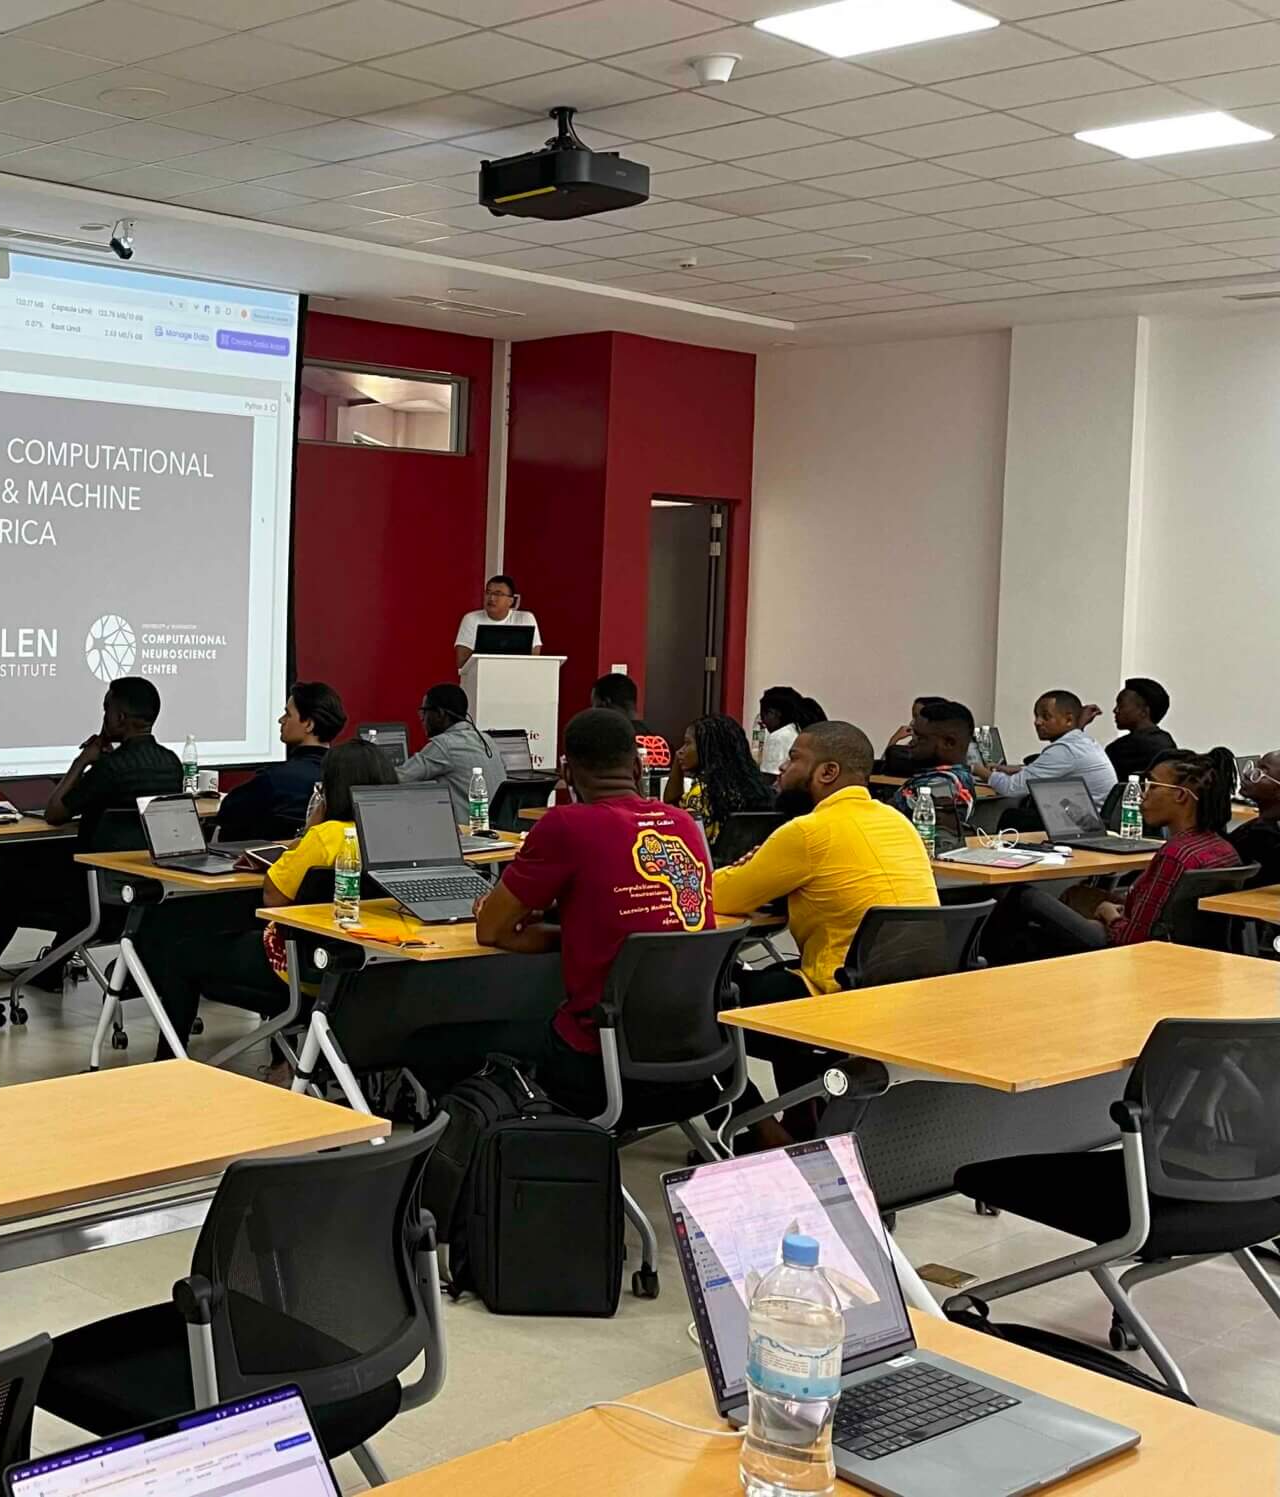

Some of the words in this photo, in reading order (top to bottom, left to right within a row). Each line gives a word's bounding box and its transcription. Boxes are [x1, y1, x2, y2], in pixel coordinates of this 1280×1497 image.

[165, 329, 192, 341] Manage
[7, 437, 215, 478] COMPUTATIONAL
[1, 477, 19, 504] &
[27, 480, 142, 511] MACHINE
[141, 633, 228, 646] COMPUTATIONAL
[141, 648, 217, 660] NEUROSCIENCE
[141, 664, 178, 675] CENTER
